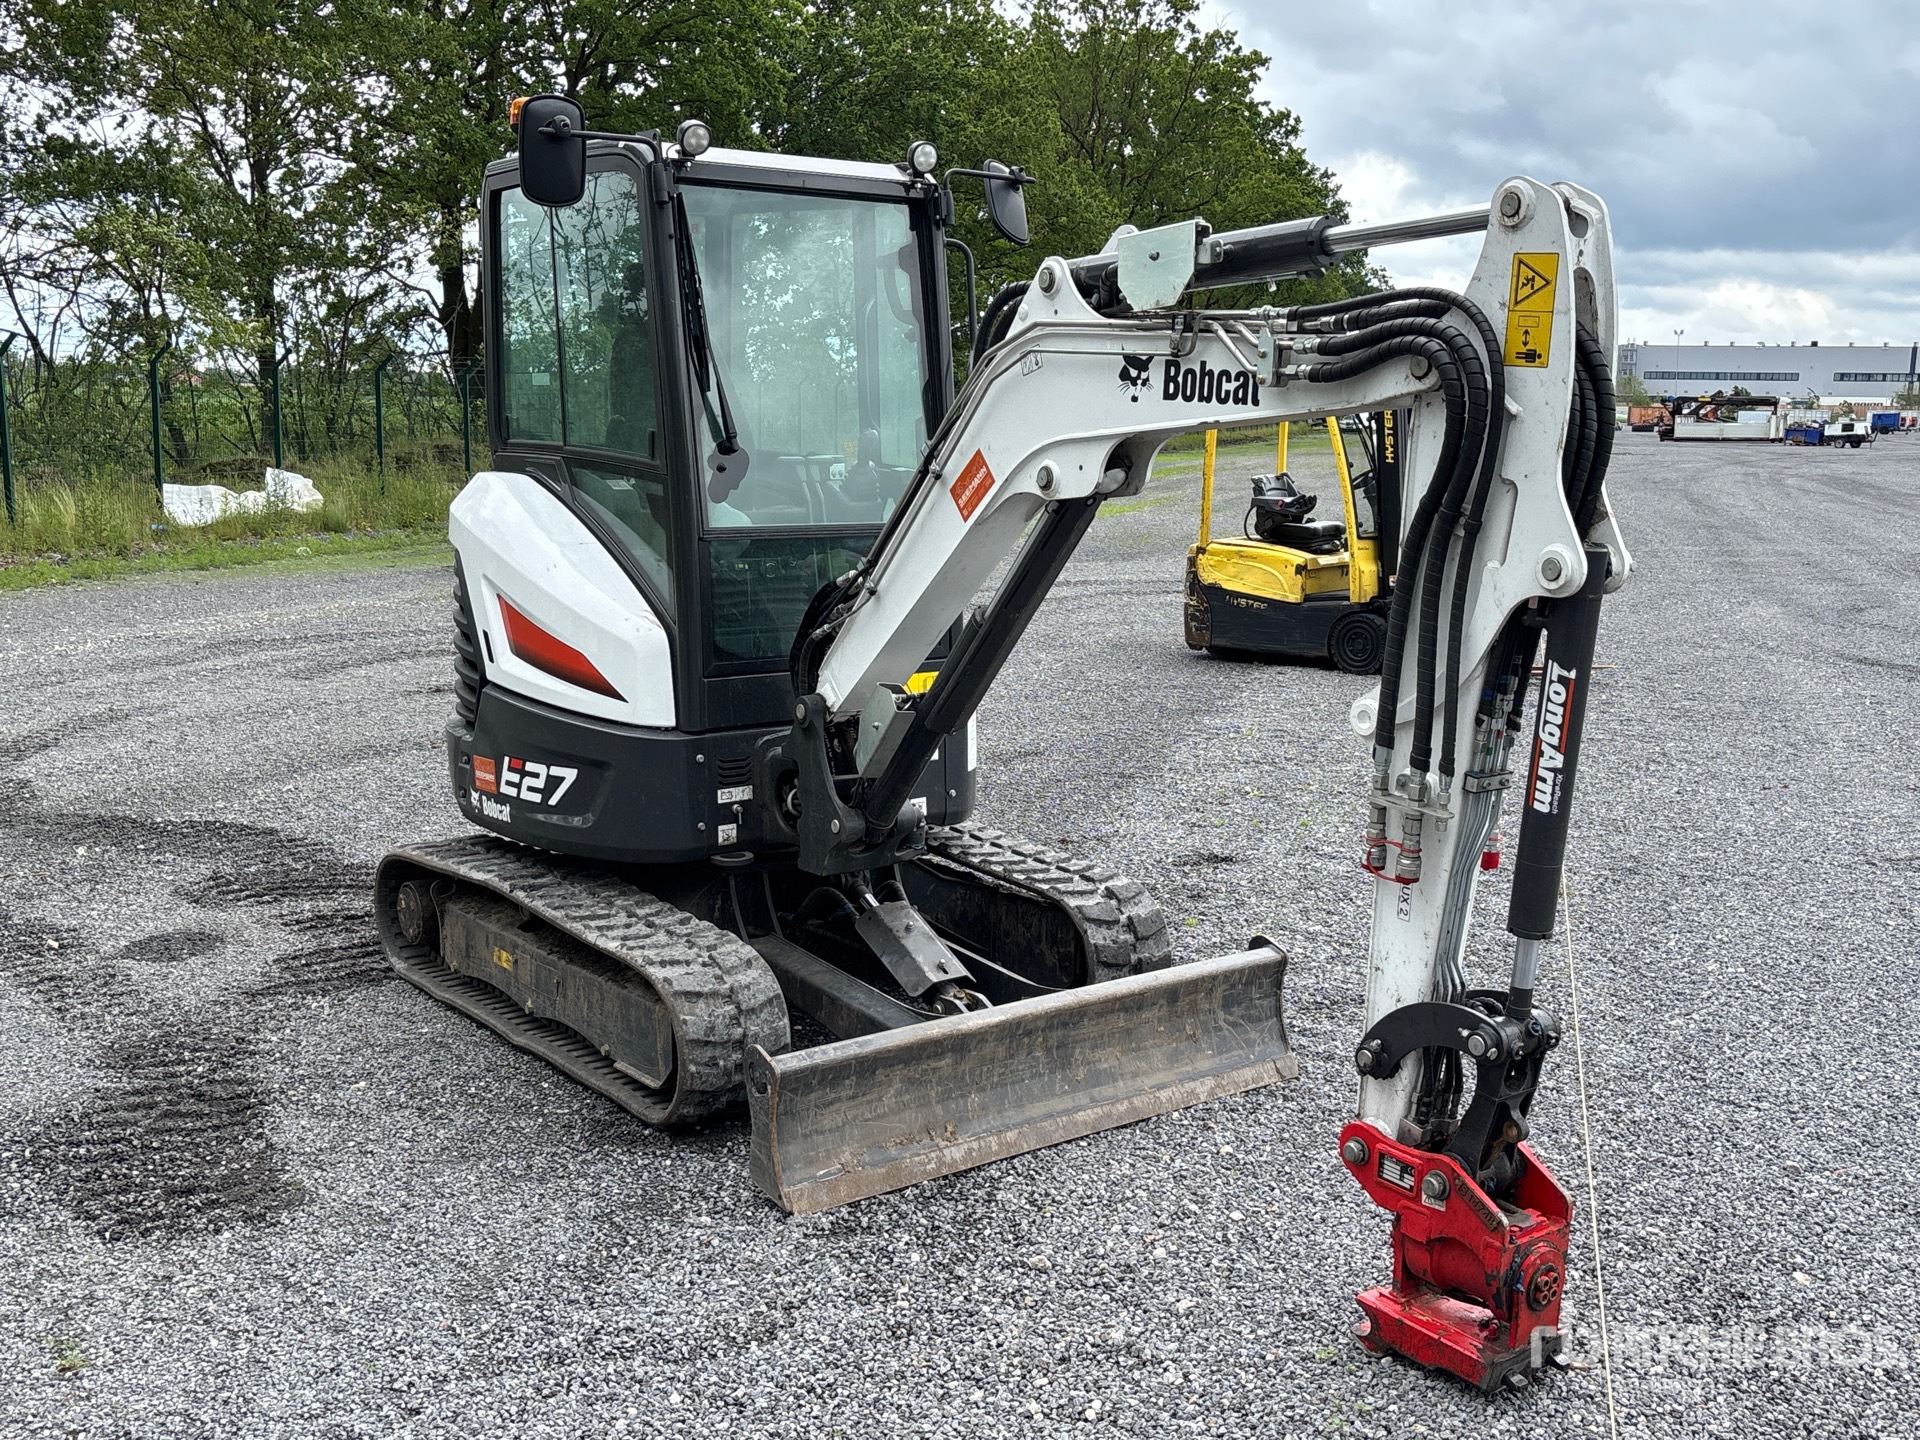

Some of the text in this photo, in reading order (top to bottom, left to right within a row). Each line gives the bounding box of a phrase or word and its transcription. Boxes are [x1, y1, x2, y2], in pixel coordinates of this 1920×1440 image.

[1162, 358, 1260, 407] Bobcat
[1383, 409, 1395, 463] HYSTER
[958, 465, 988, 509] SEEMANN
[1532, 659, 1577, 814] LongArm
[499, 755, 579, 807] E27
[481, 794, 512, 823] Bobcat
